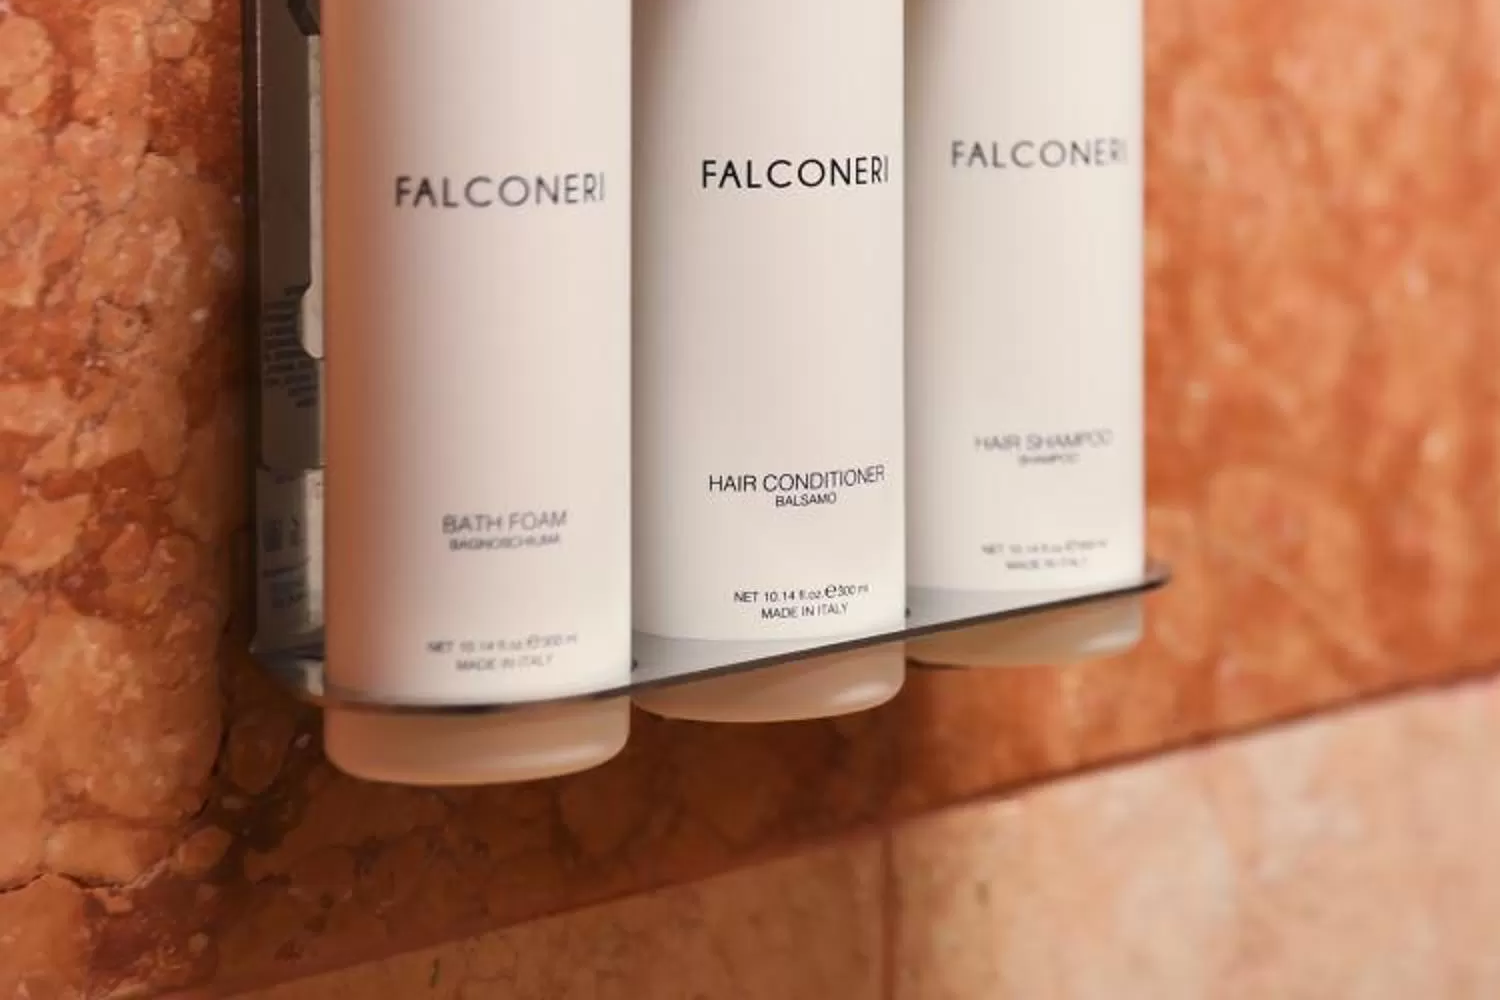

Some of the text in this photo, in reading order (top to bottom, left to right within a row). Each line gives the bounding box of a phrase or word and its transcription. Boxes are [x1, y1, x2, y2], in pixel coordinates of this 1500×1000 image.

[702, 155, 889, 189] FALCONERI
[395, 171, 605, 208] FALCONERI
[709, 464, 885, 492] HAIR CONDITIONER
[775, 492, 837, 508] BALSAMO
[441, 510, 568, 534] BATH FOAM
[734, 591, 758, 603] NET
[761, 602, 849, 620] MADE IN ITALY
